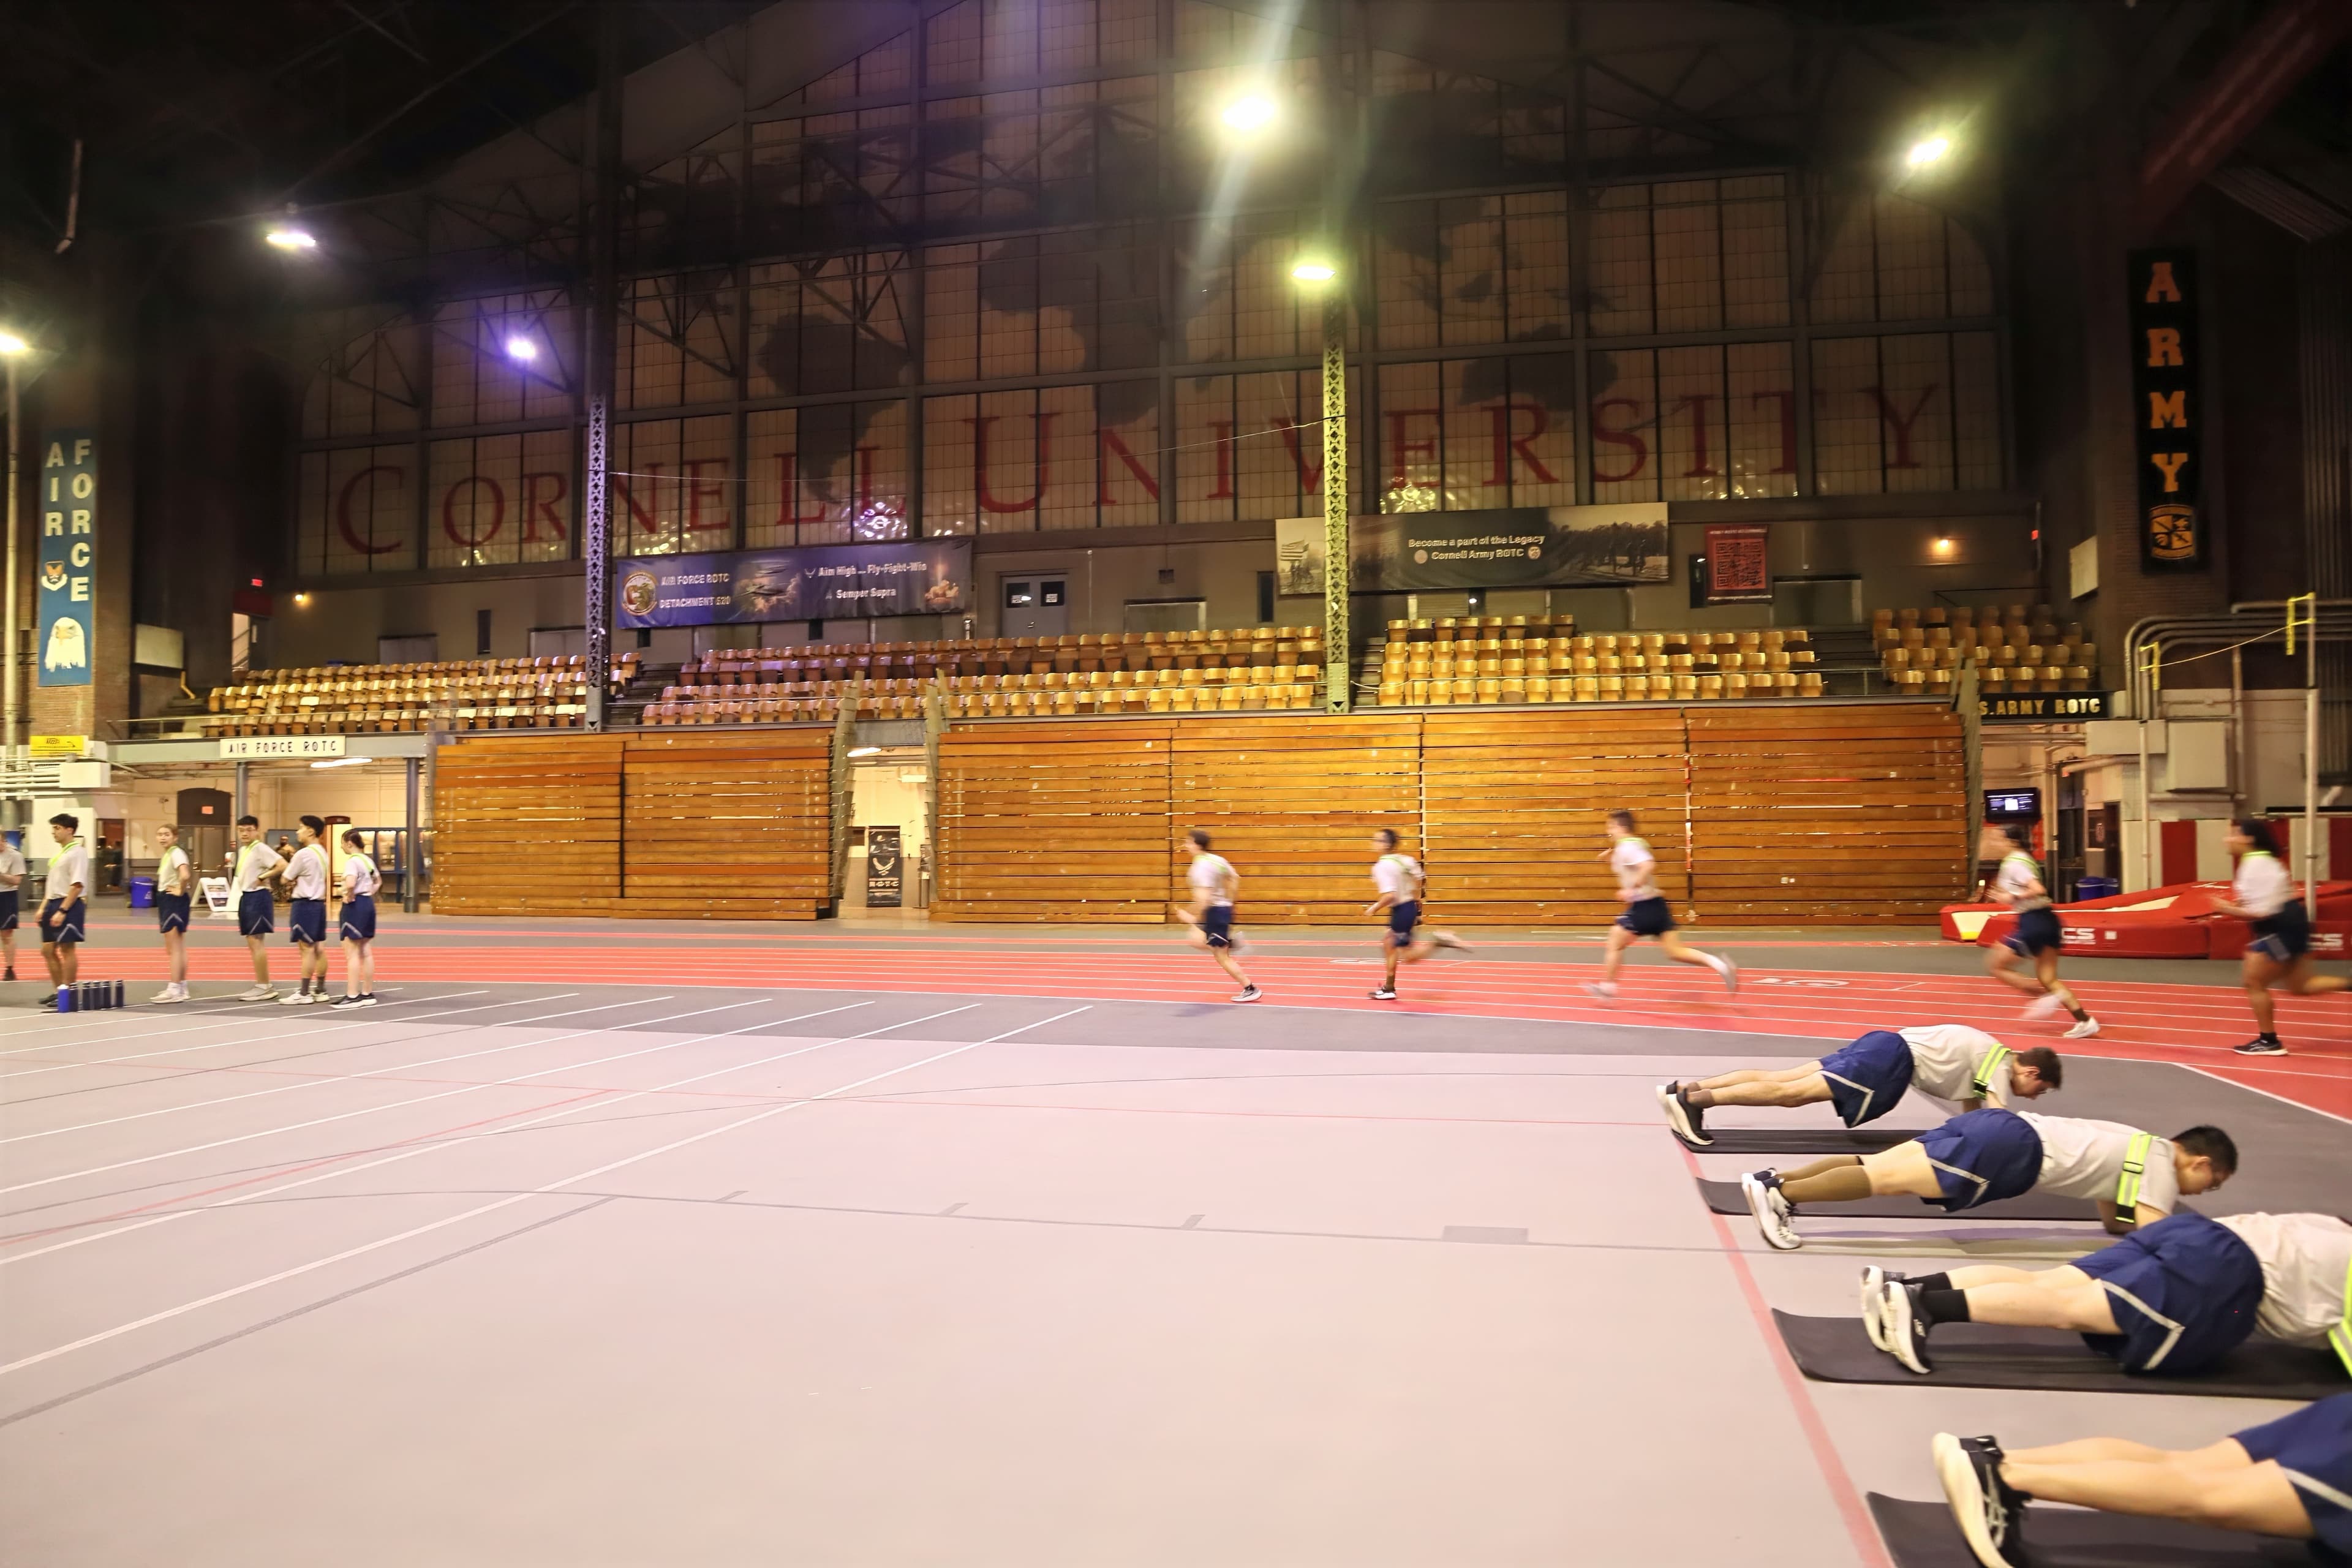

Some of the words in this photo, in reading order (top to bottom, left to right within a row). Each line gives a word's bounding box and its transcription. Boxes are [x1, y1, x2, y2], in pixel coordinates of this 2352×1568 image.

[2145, 262, 2187, 492] ARMY
[337, 446, 906, 555] CORNELL
[963, 383, 1939, 514] UNIVERSITY
[45, 442, 65, 537] AIR
[70, 439, 92, 602] FORCE
[1409, 539, 1447, 548] Become
[1457, 537, 1478, 548] part
[1490, 536, 1507, 545] the
[1509, 535, 1545, 545] Legacy
[1431, 551, 1468, 559] Cornell
[1469, 551, 1495, 560] Army
[1496, 549, 1524, 557] ROTC
[818, 567, 835, 576] Aim
[836, 566, 856, 578] High
[661, 576, 676, 586] AIR
[677, 575, 706, 585] FORCE
[706, 573, 730, 583] ROTC
[836, 589, 869, 600] Semper
[870, 587, 897, 599] Supra
[660, 597, 715, 608] DETACHMENT
[2055, 698, 2100, 714] ROTC
[229, 743, 247, 753] AIR
[256, 742, 293, 753] FORCE
[303, 741, 336, 752] ROTC
